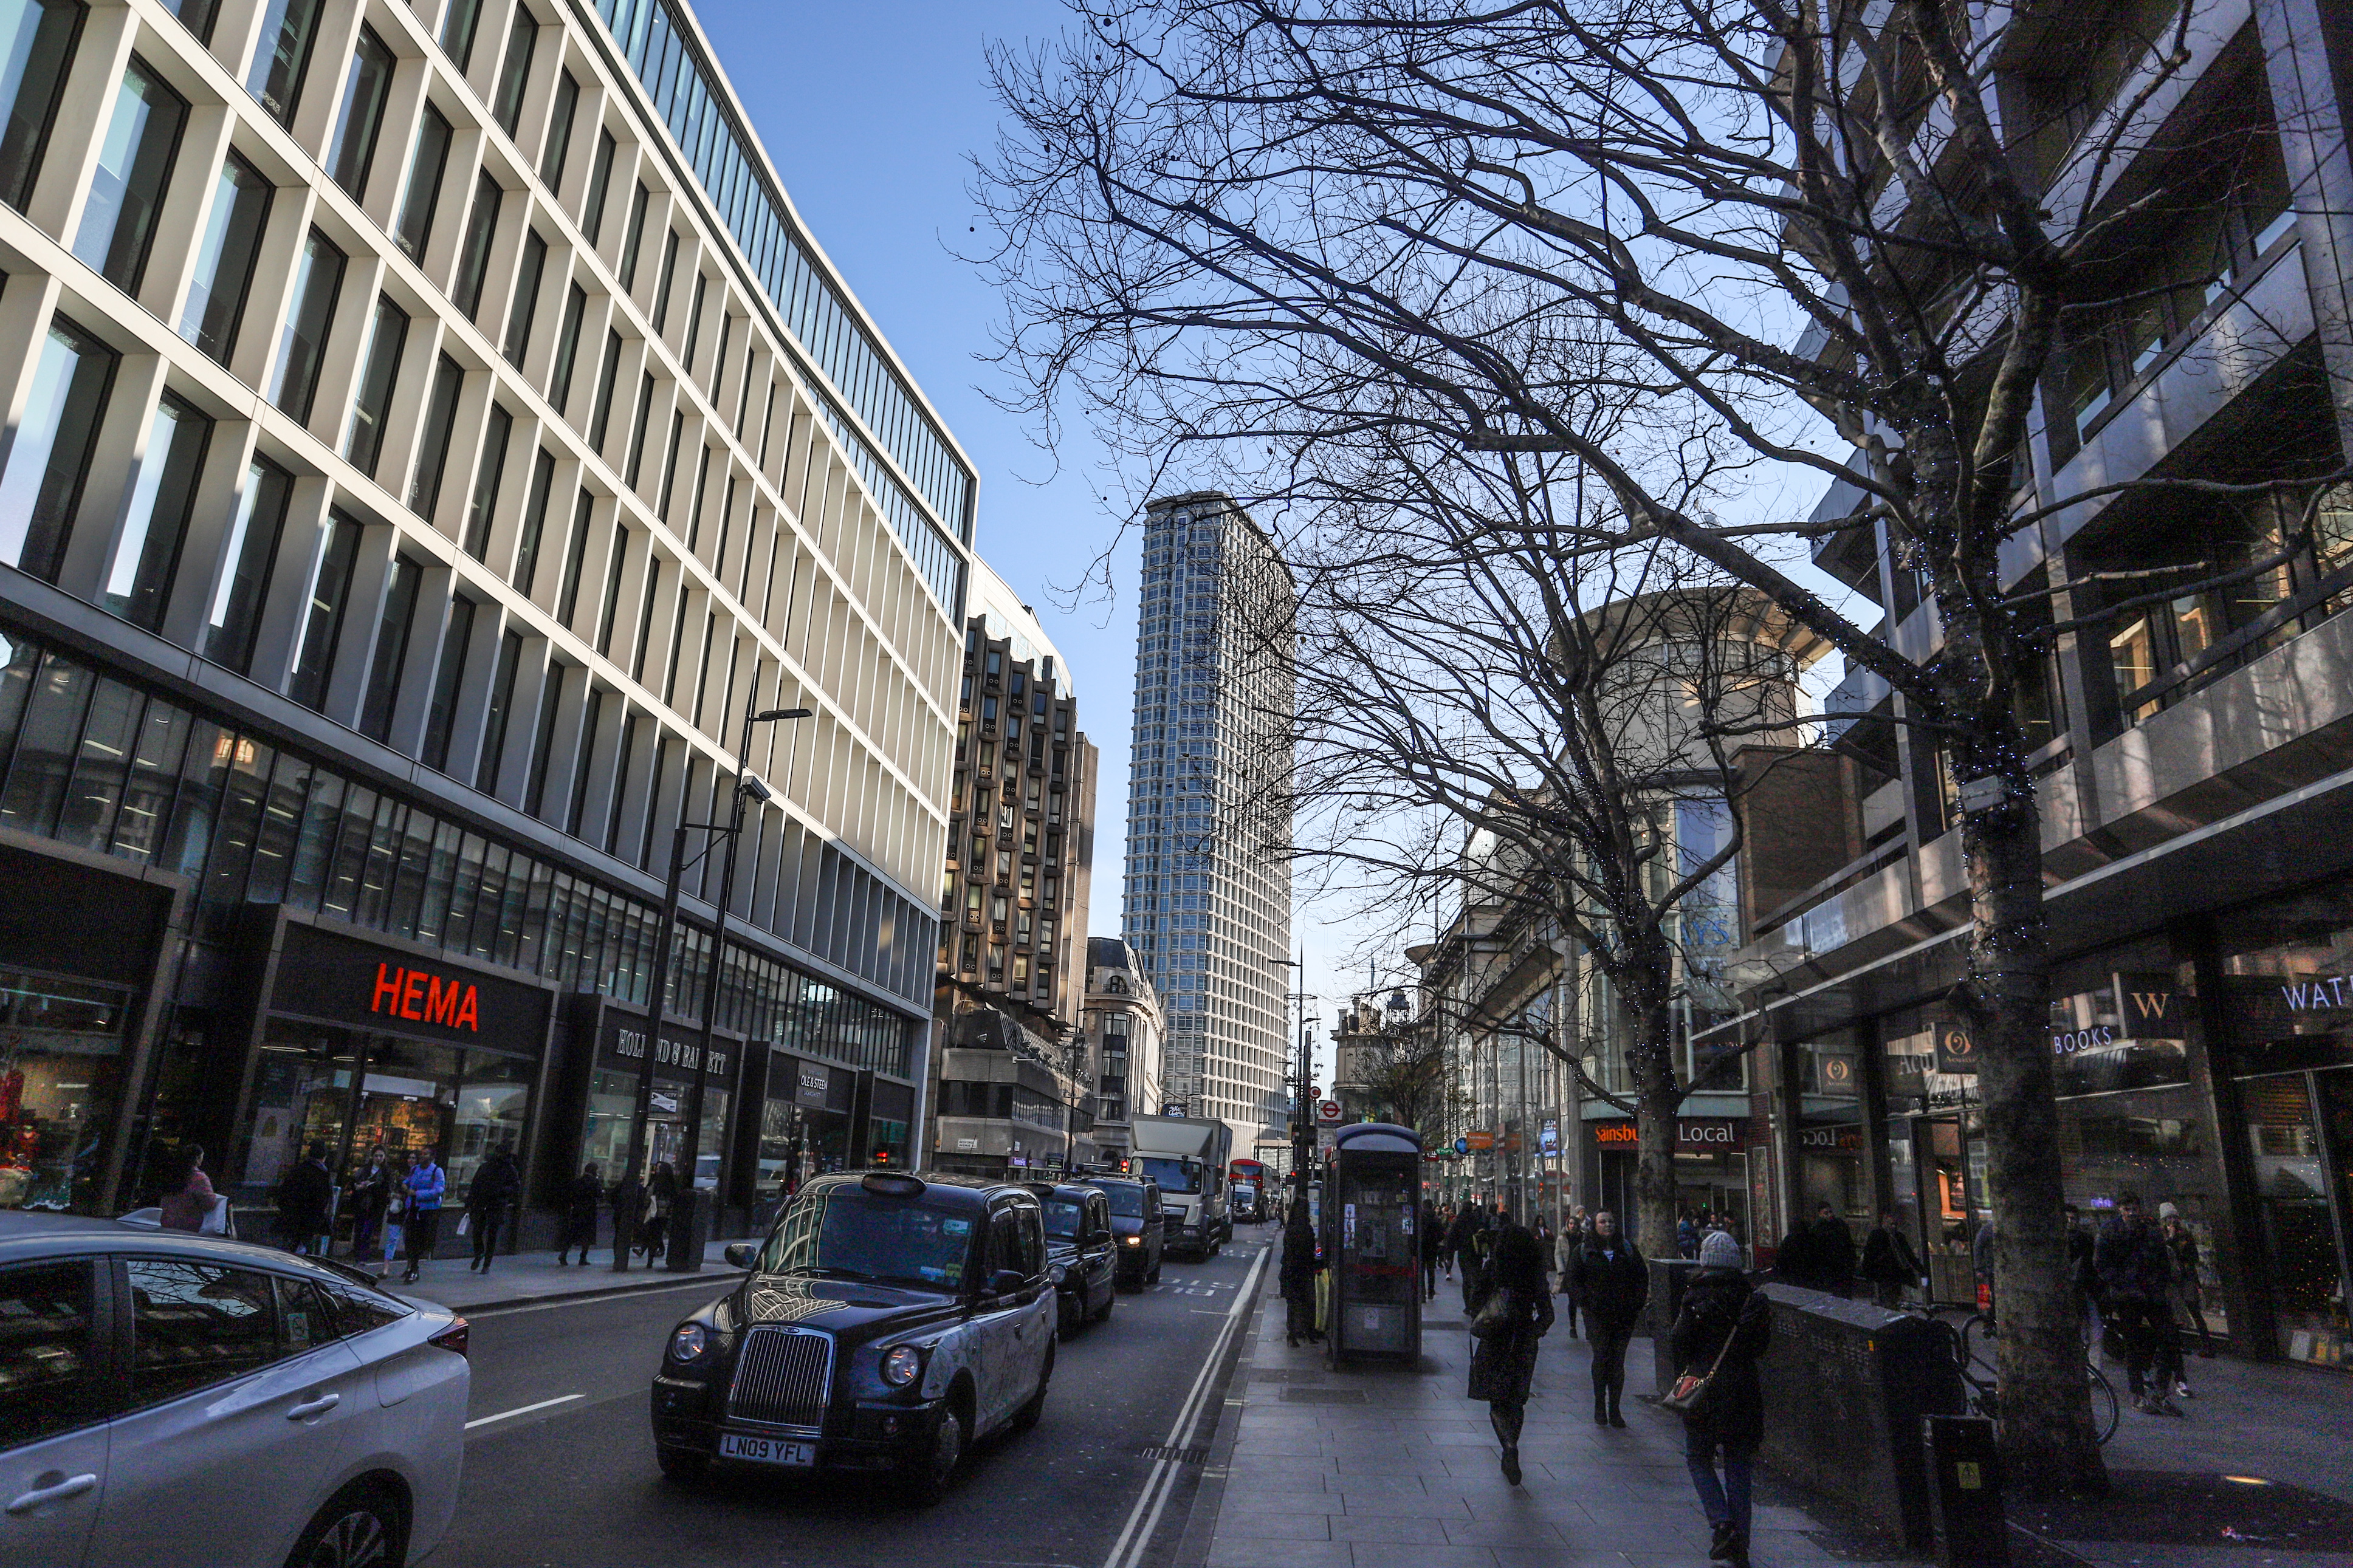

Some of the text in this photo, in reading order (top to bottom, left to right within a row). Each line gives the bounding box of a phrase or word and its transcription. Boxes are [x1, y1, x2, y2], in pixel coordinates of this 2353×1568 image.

[371, 962, 478, 1032] HEMA
[2131, 992, 2169, 1019] W
[2053, 1026, 2111, 1054] BOOKS
[672, 1042, 681, 1066] &
[801, 1075, 810, 1087] OLE
[814, 1078, 828, 1090] STEEN
[1679, 1122, 1735, 1142] Local
[726, 1436, 806, 1462] LN09 YFL
